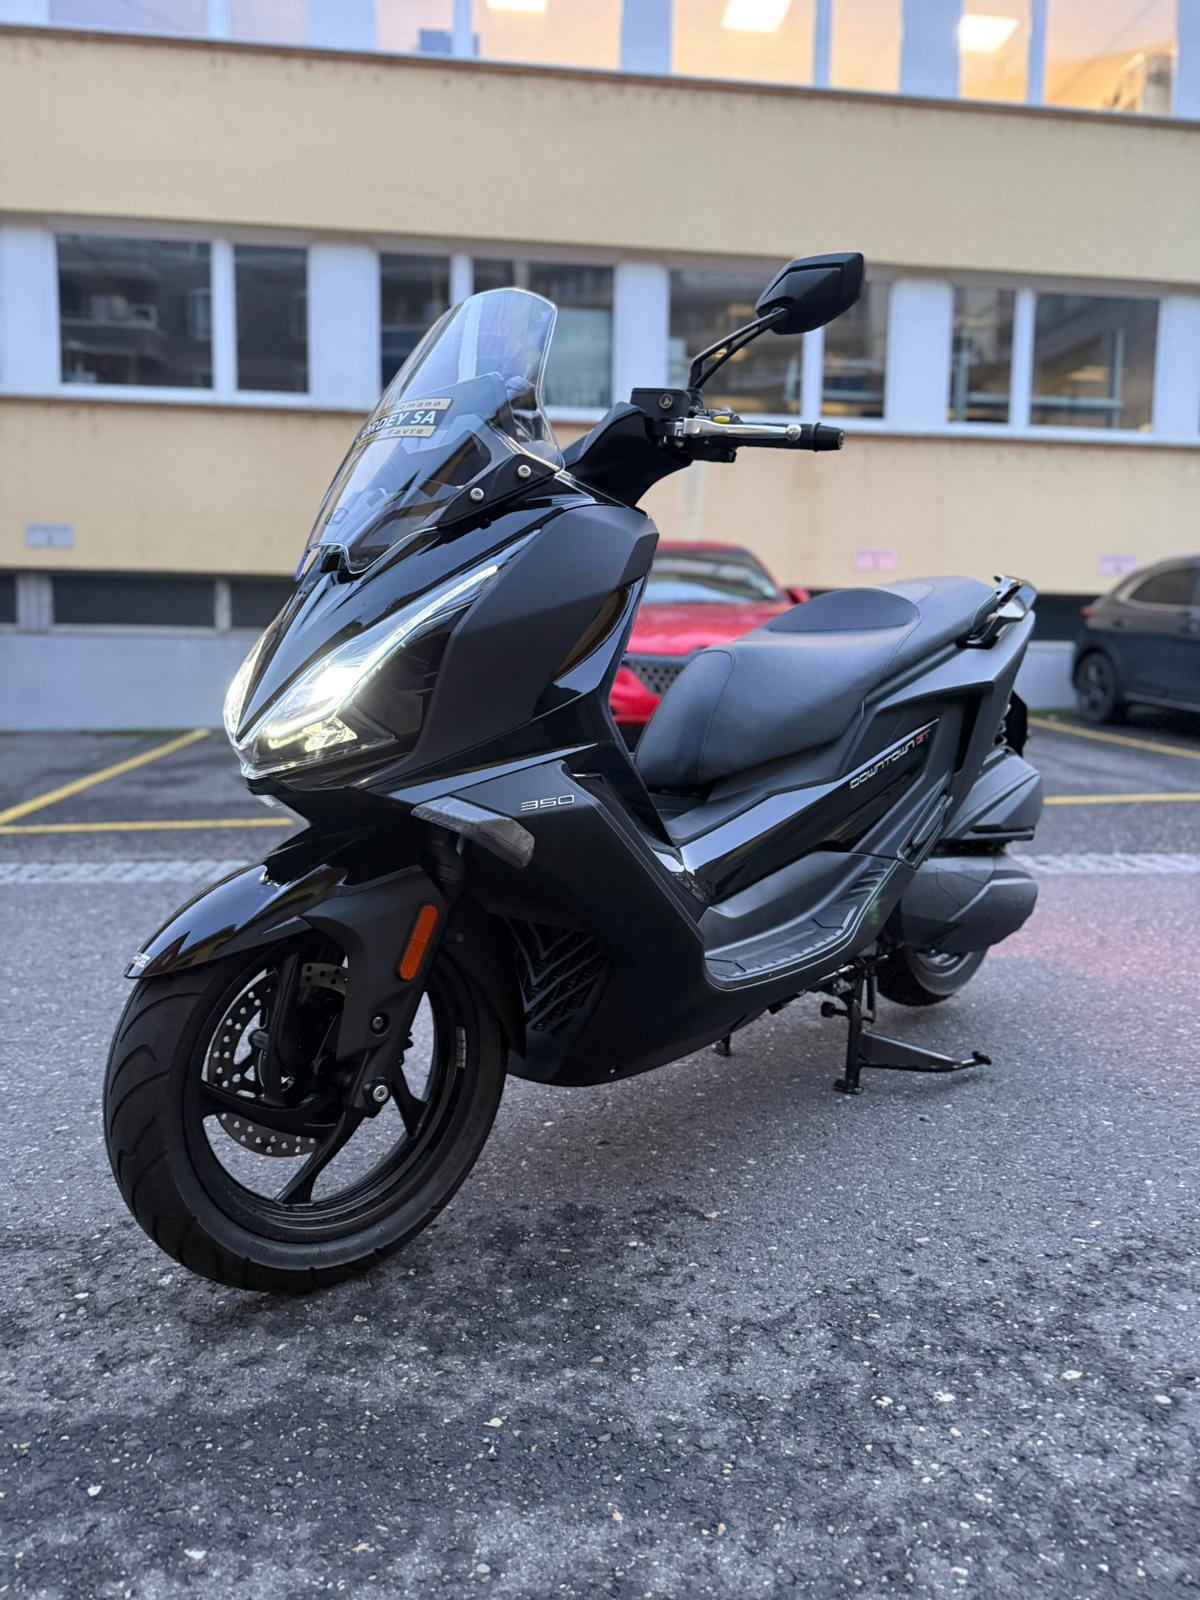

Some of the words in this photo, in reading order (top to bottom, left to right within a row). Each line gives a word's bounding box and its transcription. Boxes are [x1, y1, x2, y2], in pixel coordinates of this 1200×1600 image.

[410, 410, 437, 424] SA
[850, 740, 915, 789] DOWNTOWN
[520, 794, 575, 812] 350
